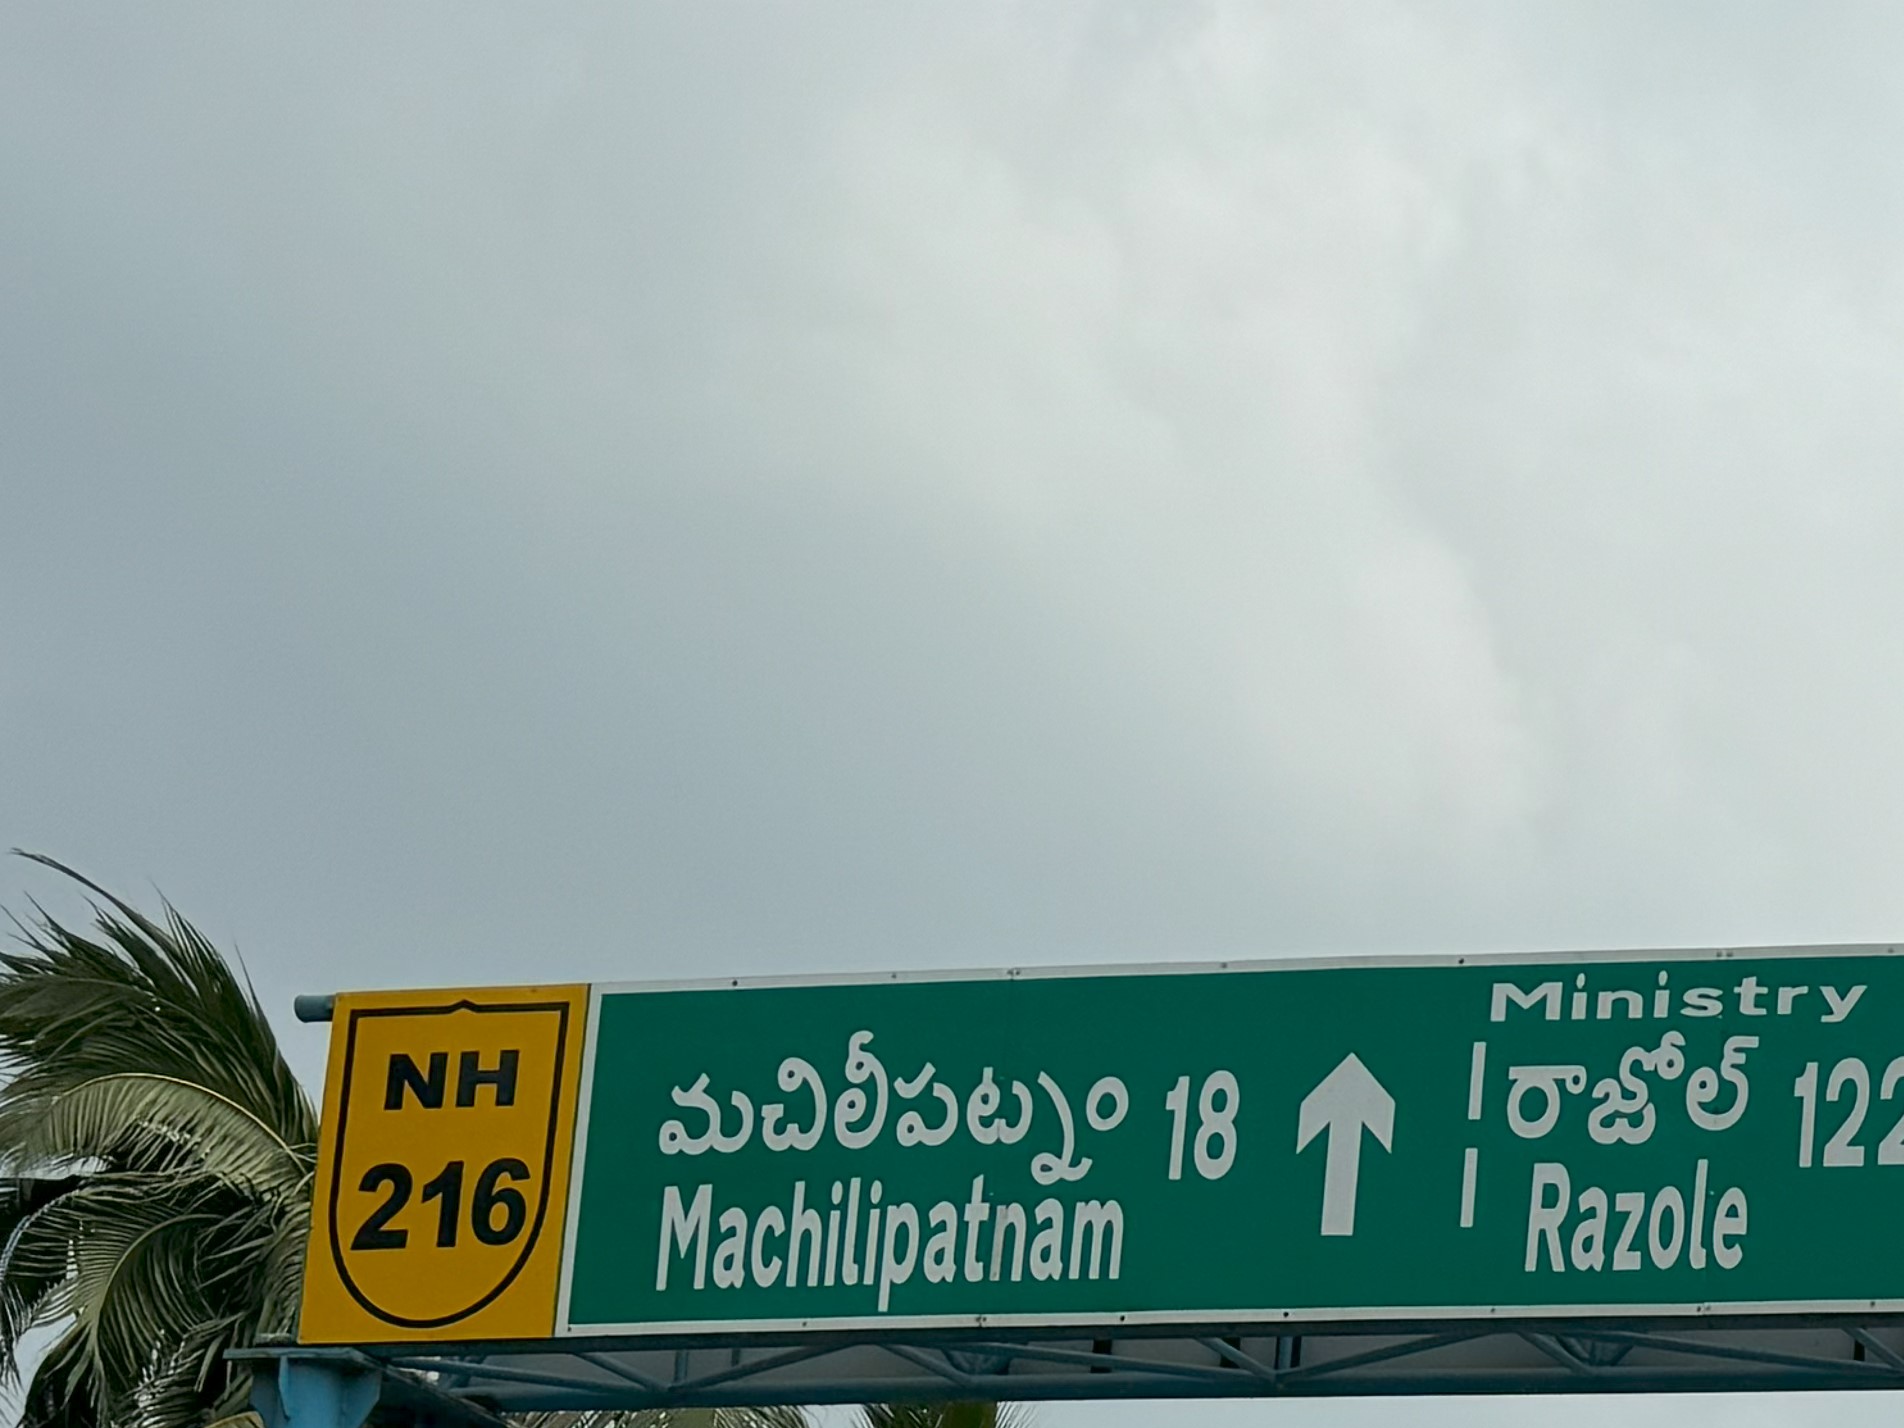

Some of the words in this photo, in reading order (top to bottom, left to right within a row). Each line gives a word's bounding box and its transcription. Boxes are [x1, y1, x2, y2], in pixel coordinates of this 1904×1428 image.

[1491, 971, 1866, 1022] Ministry
[384, 1049, 520, 1110] NH
[659, 1031, 1128, 1185] మచిలీపట్నం
[1166, 1071, 1239, 1180] 18
[350, 1158, 531, 1251] 216
[656, 1175, 1123, 1312] Machilipatnam
[1525, 1159, 1747, 1272] Razole
